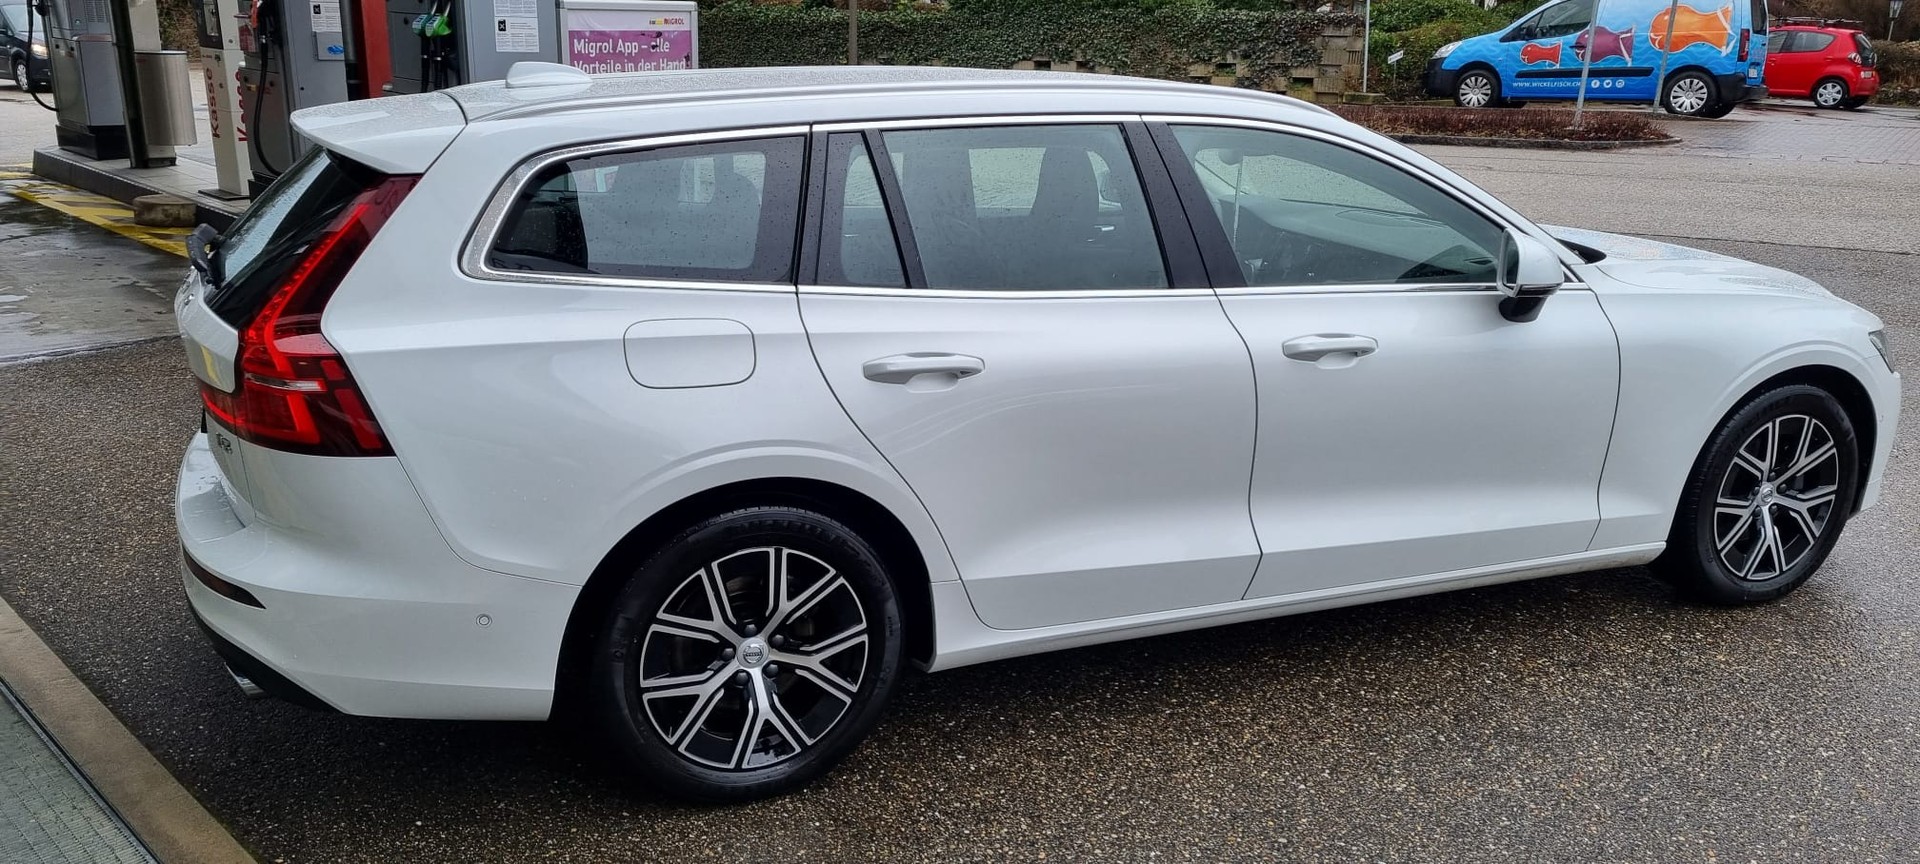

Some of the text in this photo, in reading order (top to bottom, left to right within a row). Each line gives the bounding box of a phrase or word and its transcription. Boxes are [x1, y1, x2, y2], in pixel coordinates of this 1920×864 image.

[574, 39, 613, 57] Migrol
[616, 39, 639, 56] App
[624, 59, 635, 73] in
[638, 58, 657, 72] der
[206, 68, 220, 138] Kasse
